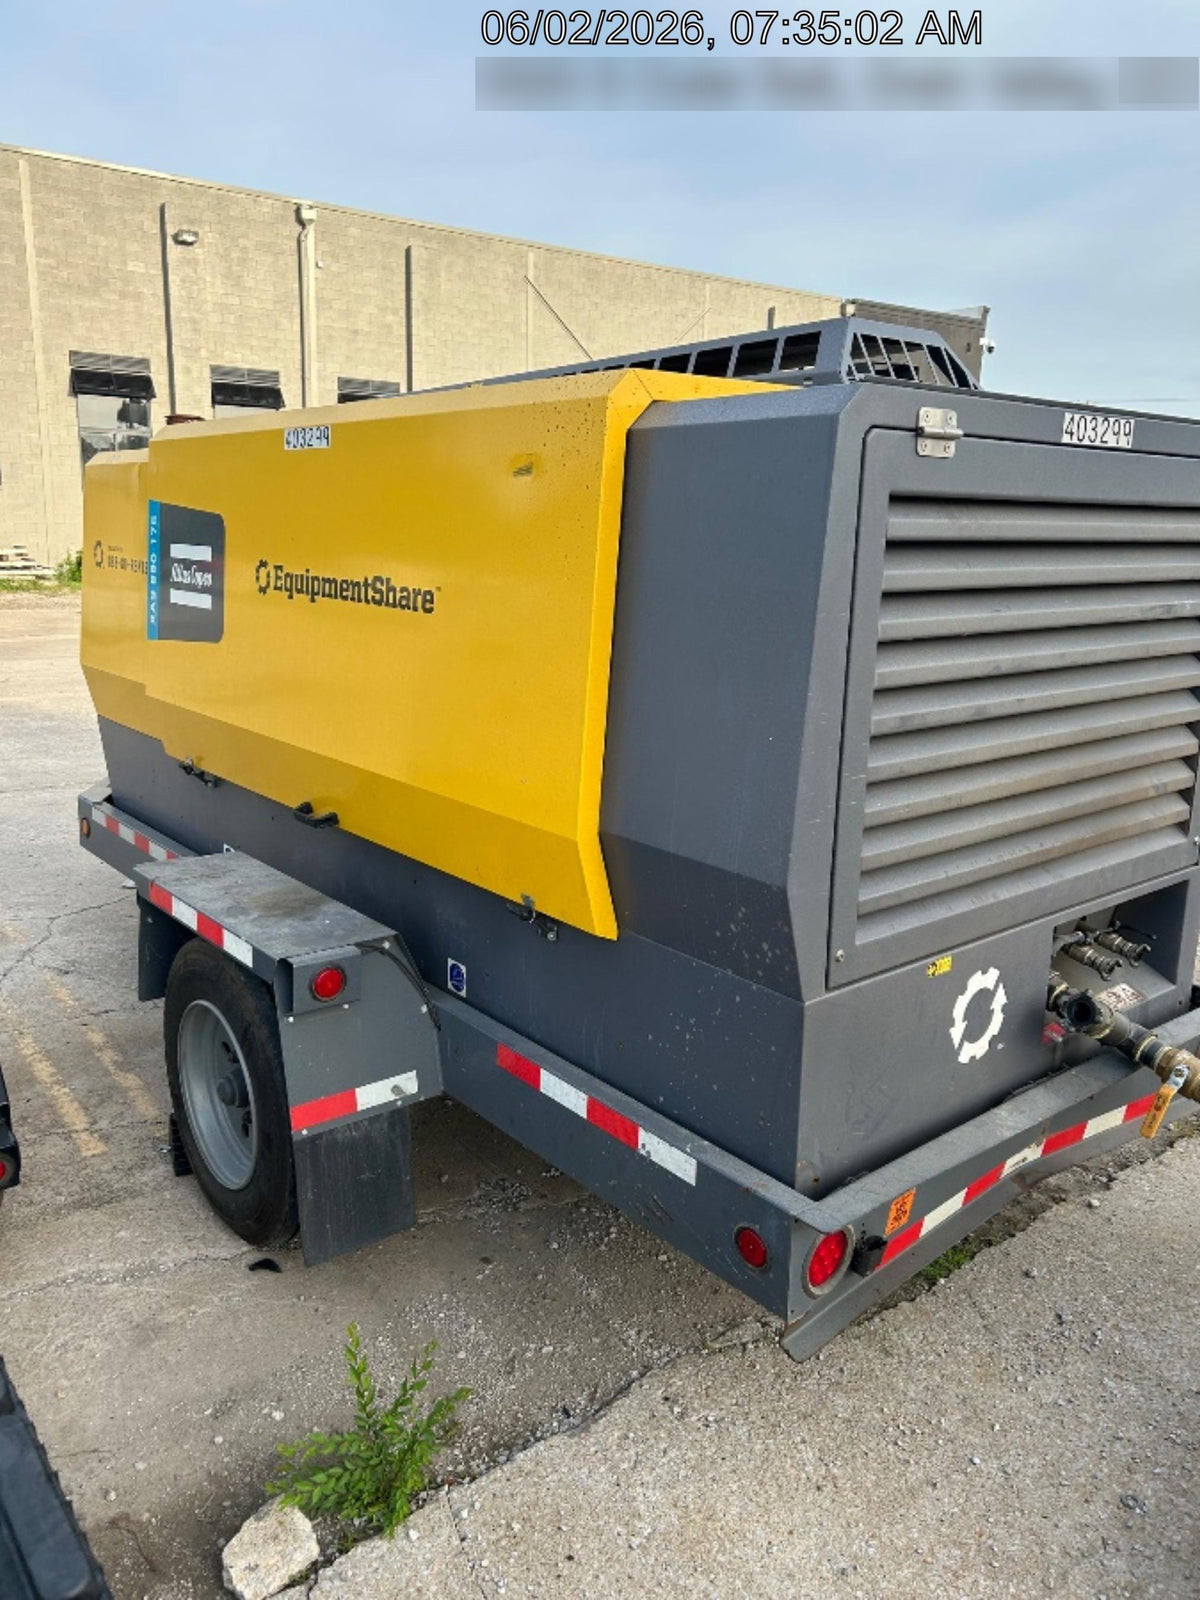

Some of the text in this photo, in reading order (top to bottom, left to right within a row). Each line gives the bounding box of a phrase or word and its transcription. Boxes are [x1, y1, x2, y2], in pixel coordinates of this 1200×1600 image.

[285, 426, 330, 449] 403299
[1064, 415, 1132, 447] 403299
[273, 564, 435, 614] EquipmentShare
